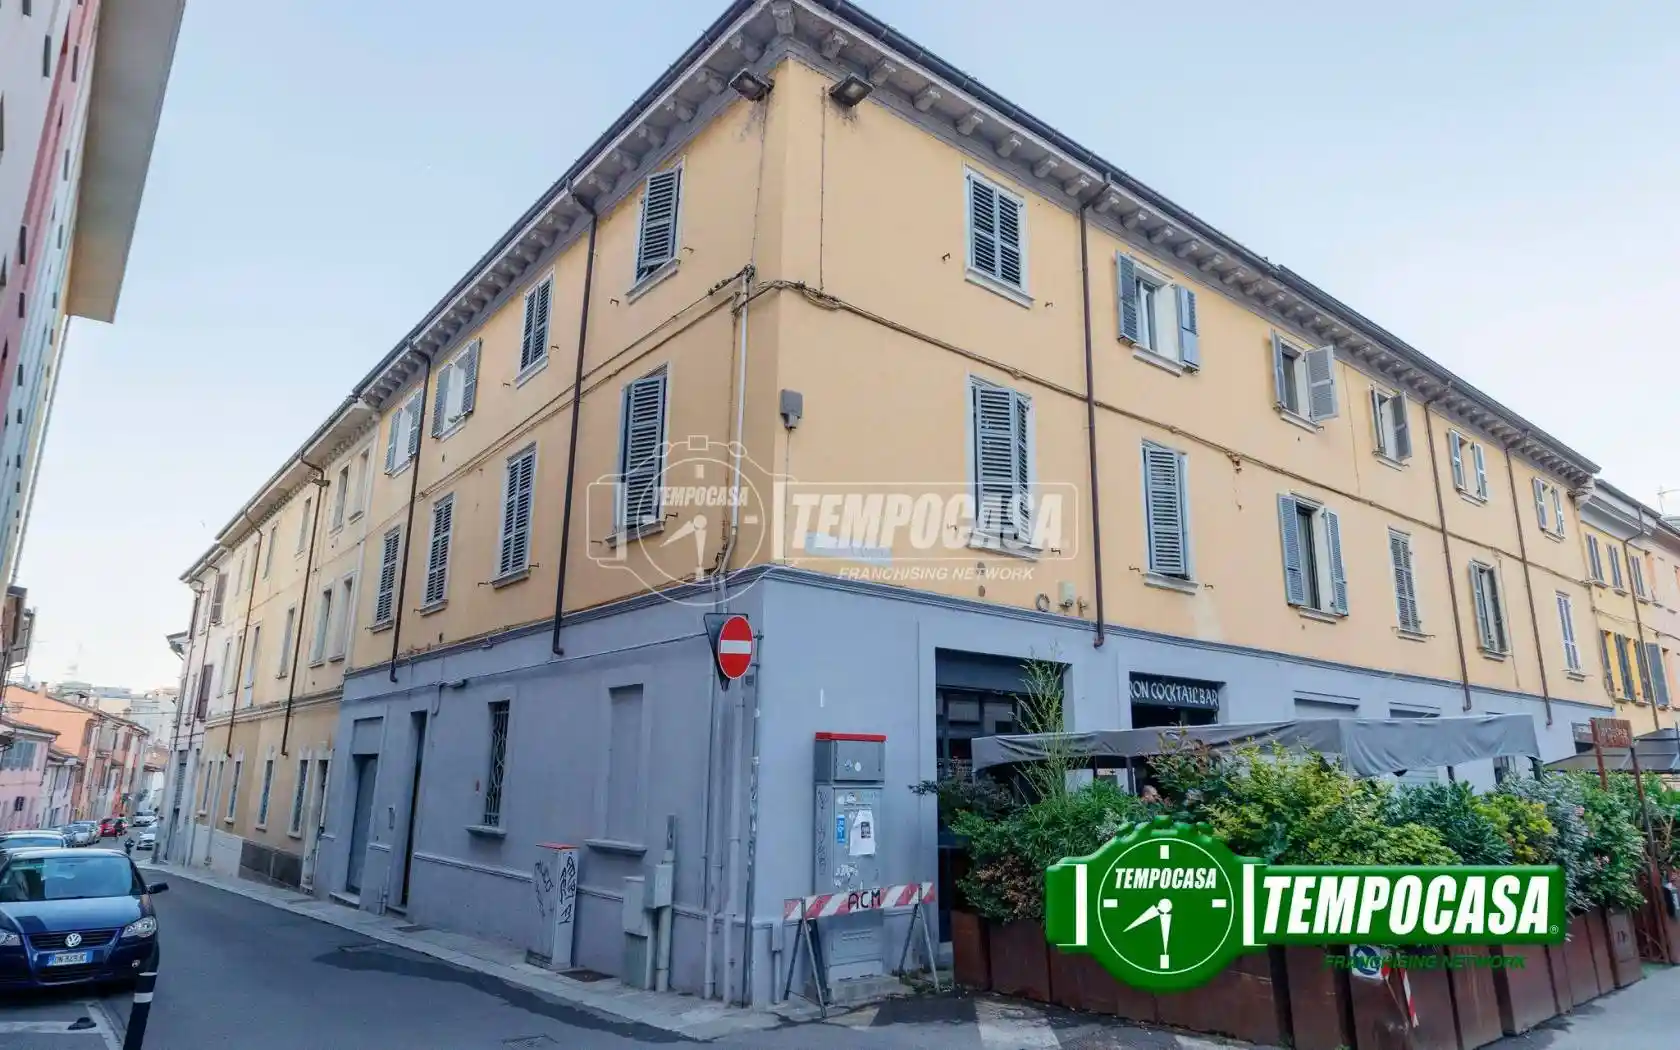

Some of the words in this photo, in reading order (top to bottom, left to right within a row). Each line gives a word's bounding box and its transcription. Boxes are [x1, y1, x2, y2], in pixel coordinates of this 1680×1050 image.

[1150, 682, 1199, 704] COCKTAIL
[1200, 687, 1219, 707] BAR
[847, 889, 881, 910] ACM
